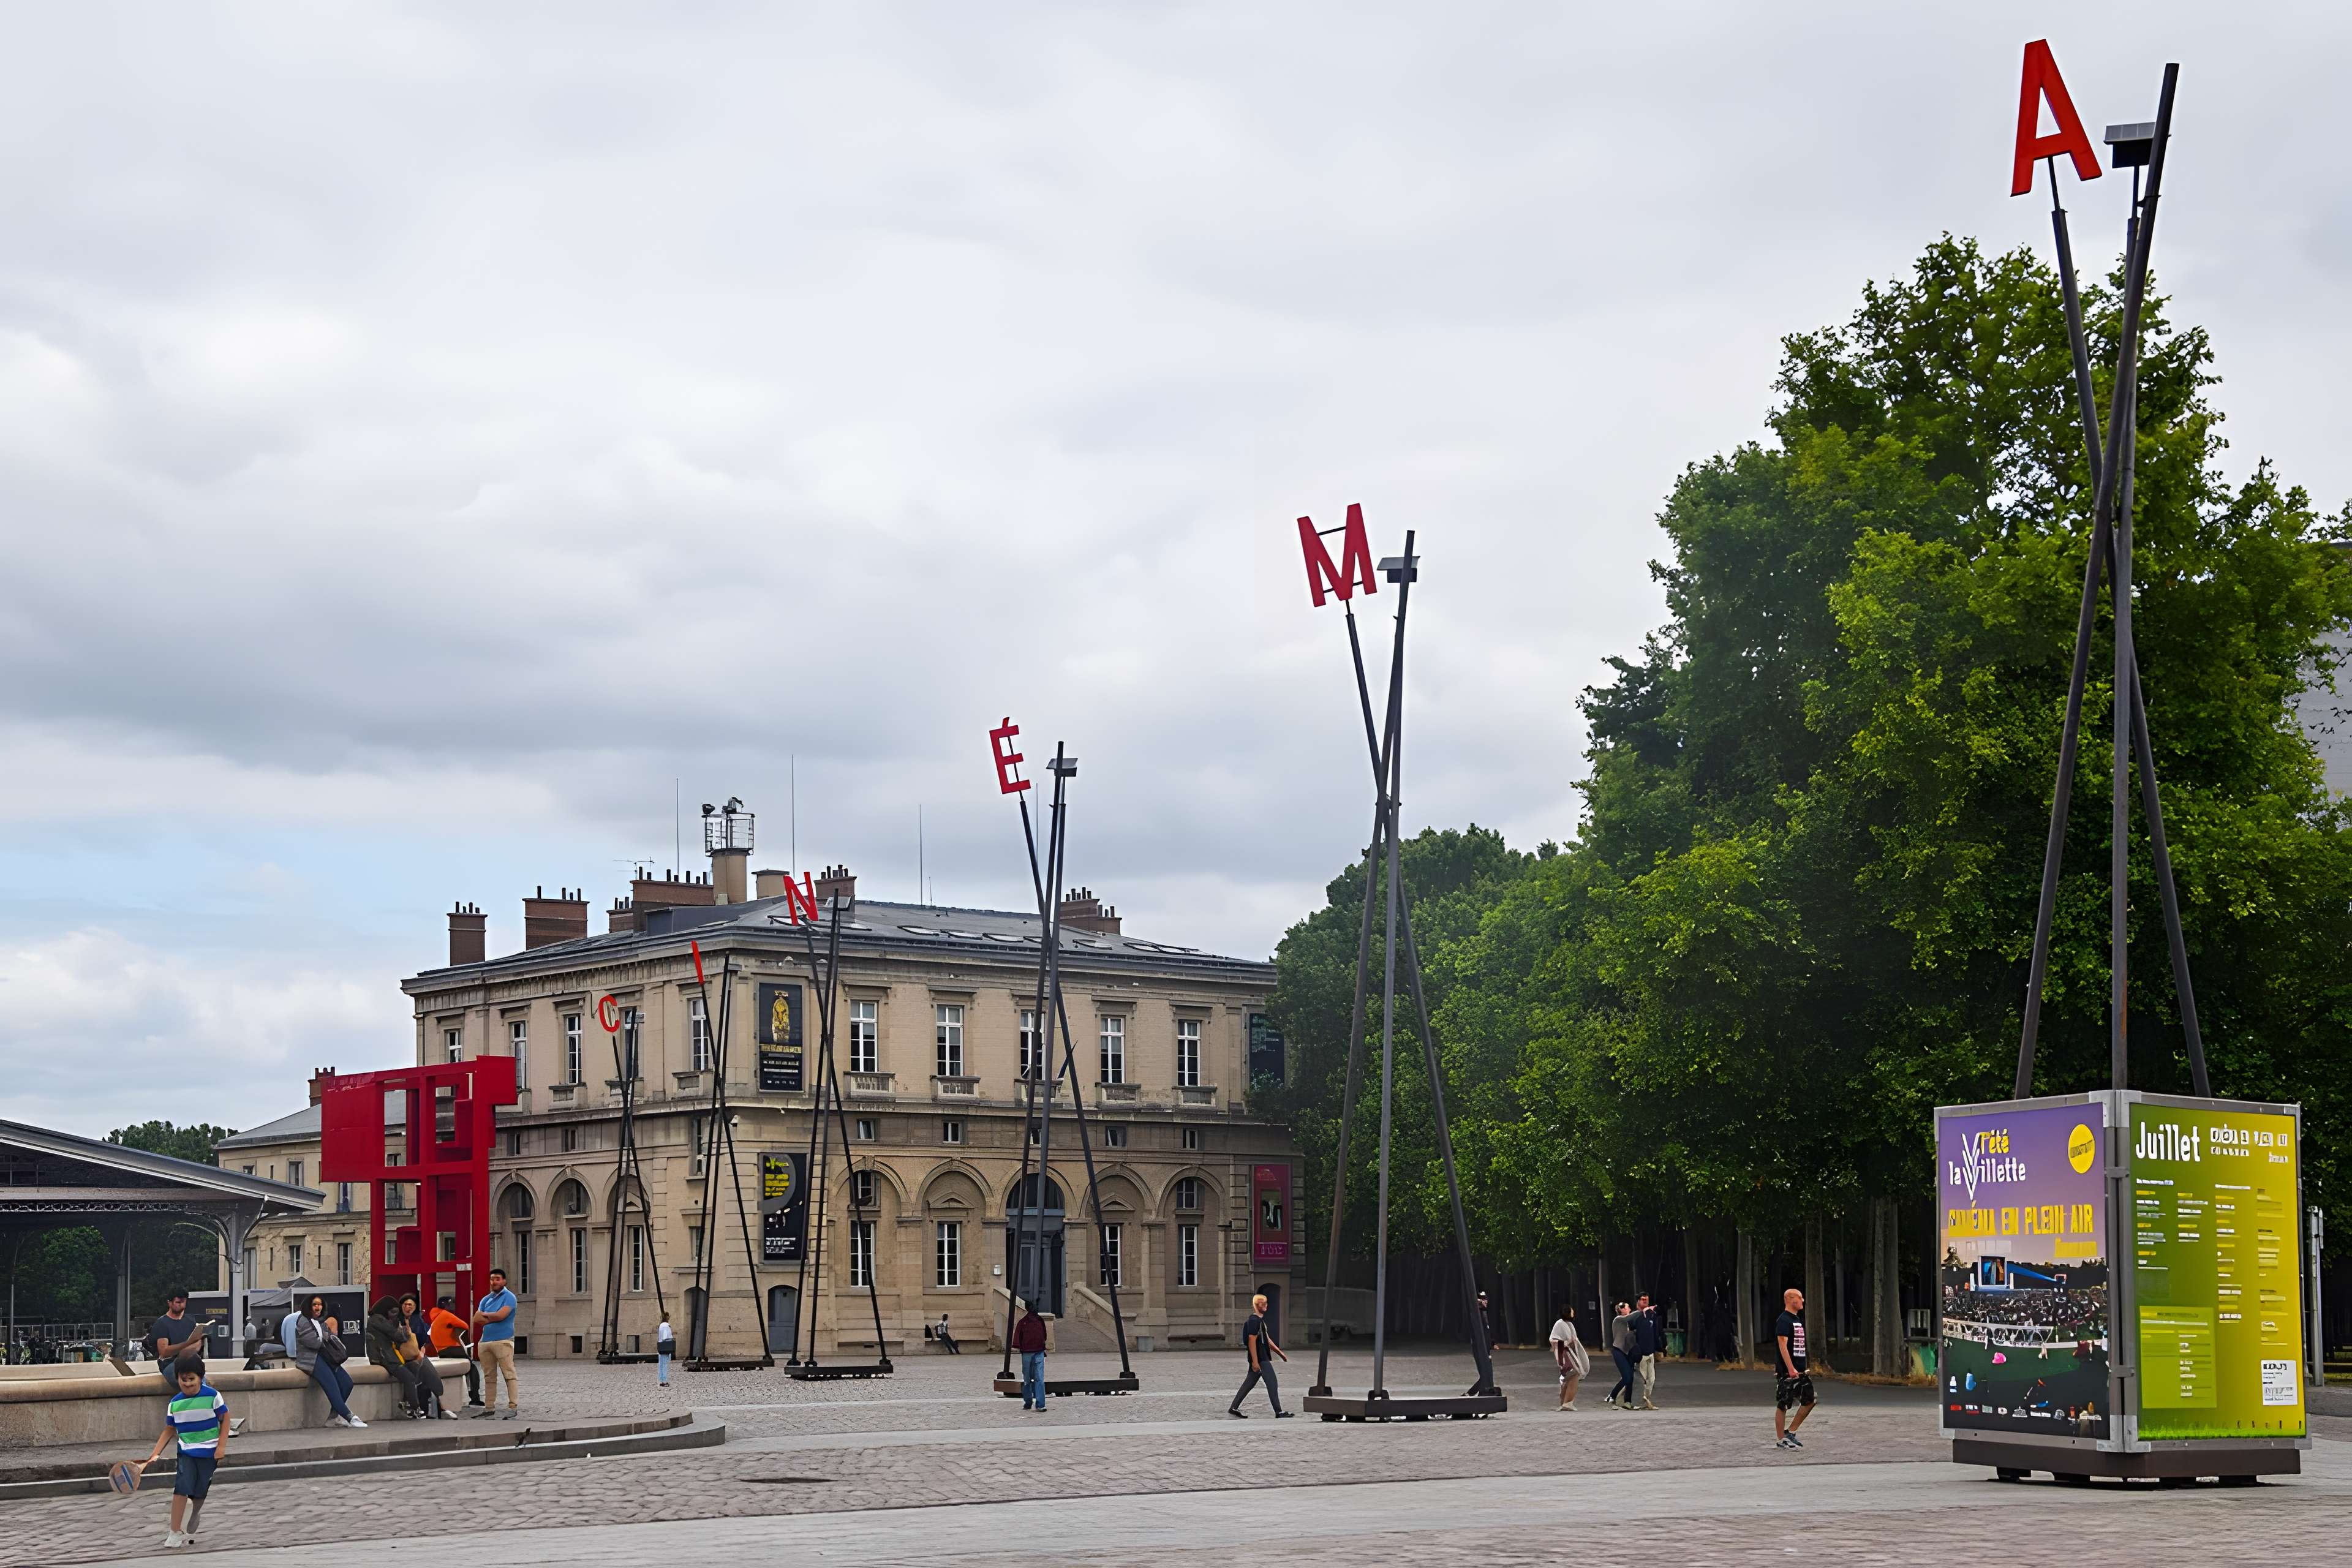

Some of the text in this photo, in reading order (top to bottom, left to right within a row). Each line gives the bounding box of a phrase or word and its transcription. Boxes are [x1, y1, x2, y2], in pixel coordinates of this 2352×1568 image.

[2010, 39, 2103, 197] A
[1297, 502, 1378, 608] M
[989, 717, 1031, 794] É
[783, 871, 819, 927] N
[598, 993, 620, 1033] C
[2135, 1121, 2201, 1162] Juillet
[1948, 1161, 1962, 1185] la
